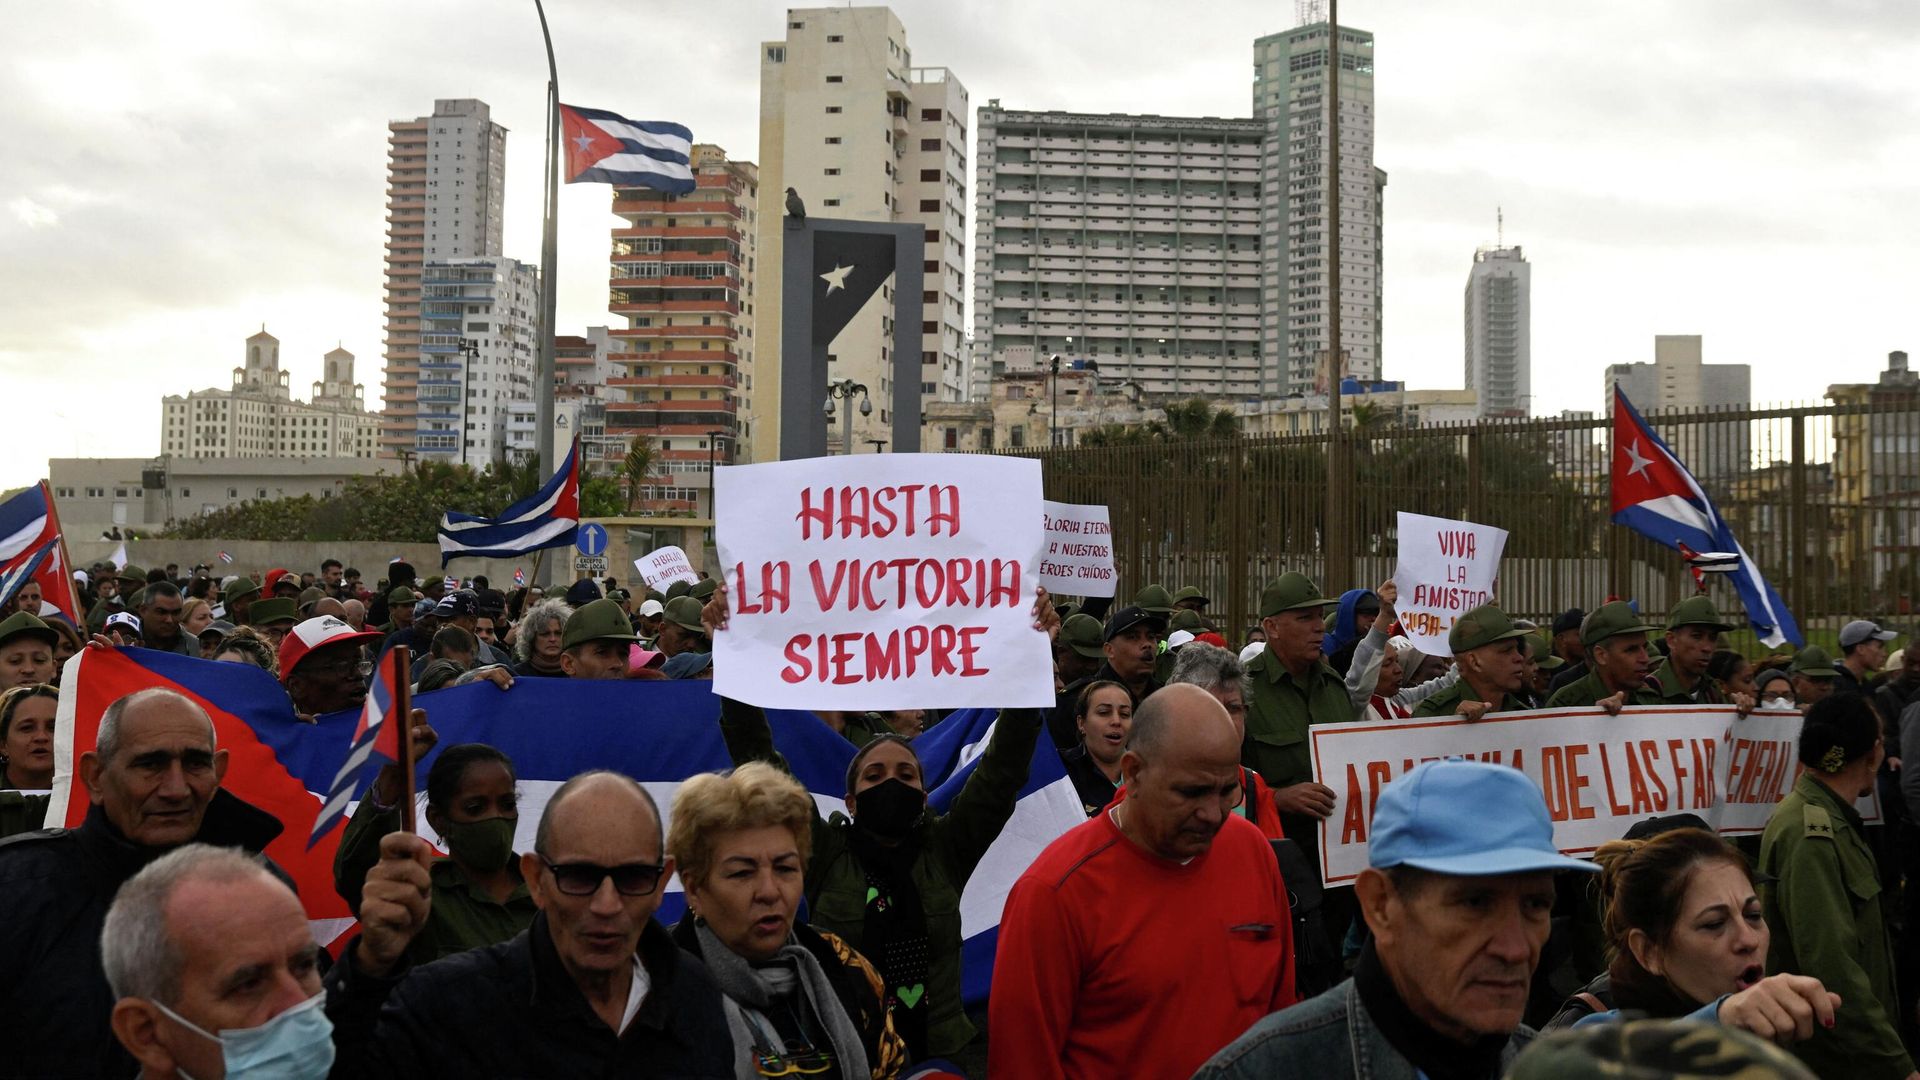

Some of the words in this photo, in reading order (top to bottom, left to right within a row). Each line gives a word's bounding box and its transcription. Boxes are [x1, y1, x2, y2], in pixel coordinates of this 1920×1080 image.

[795, 484, 960, 541] HASTA
[1083, 521, 1111, 535] ETERN
[1049, 541, 1058, 554] A
[1062, 543, 1108, 558] NUESTROS
[1438, 530, 1476, 560] VIVA
[652, 552, 682, 568] ABAJO
[1040, 560, 1074, 577] ÉROES
[646, 575, 659, 586] EL
[1447, 564, 1466, 584] LA
[736, 559, 790, 615] LA
[808, 557, 1022, 613] VICTORIA
[781, 624, 990, 685] SIEMPRE
[1541, 744, 1596, 822] DE
[1599, 740, 1668, 817] LAS
[1667, 738, 1716, 810] FAR
